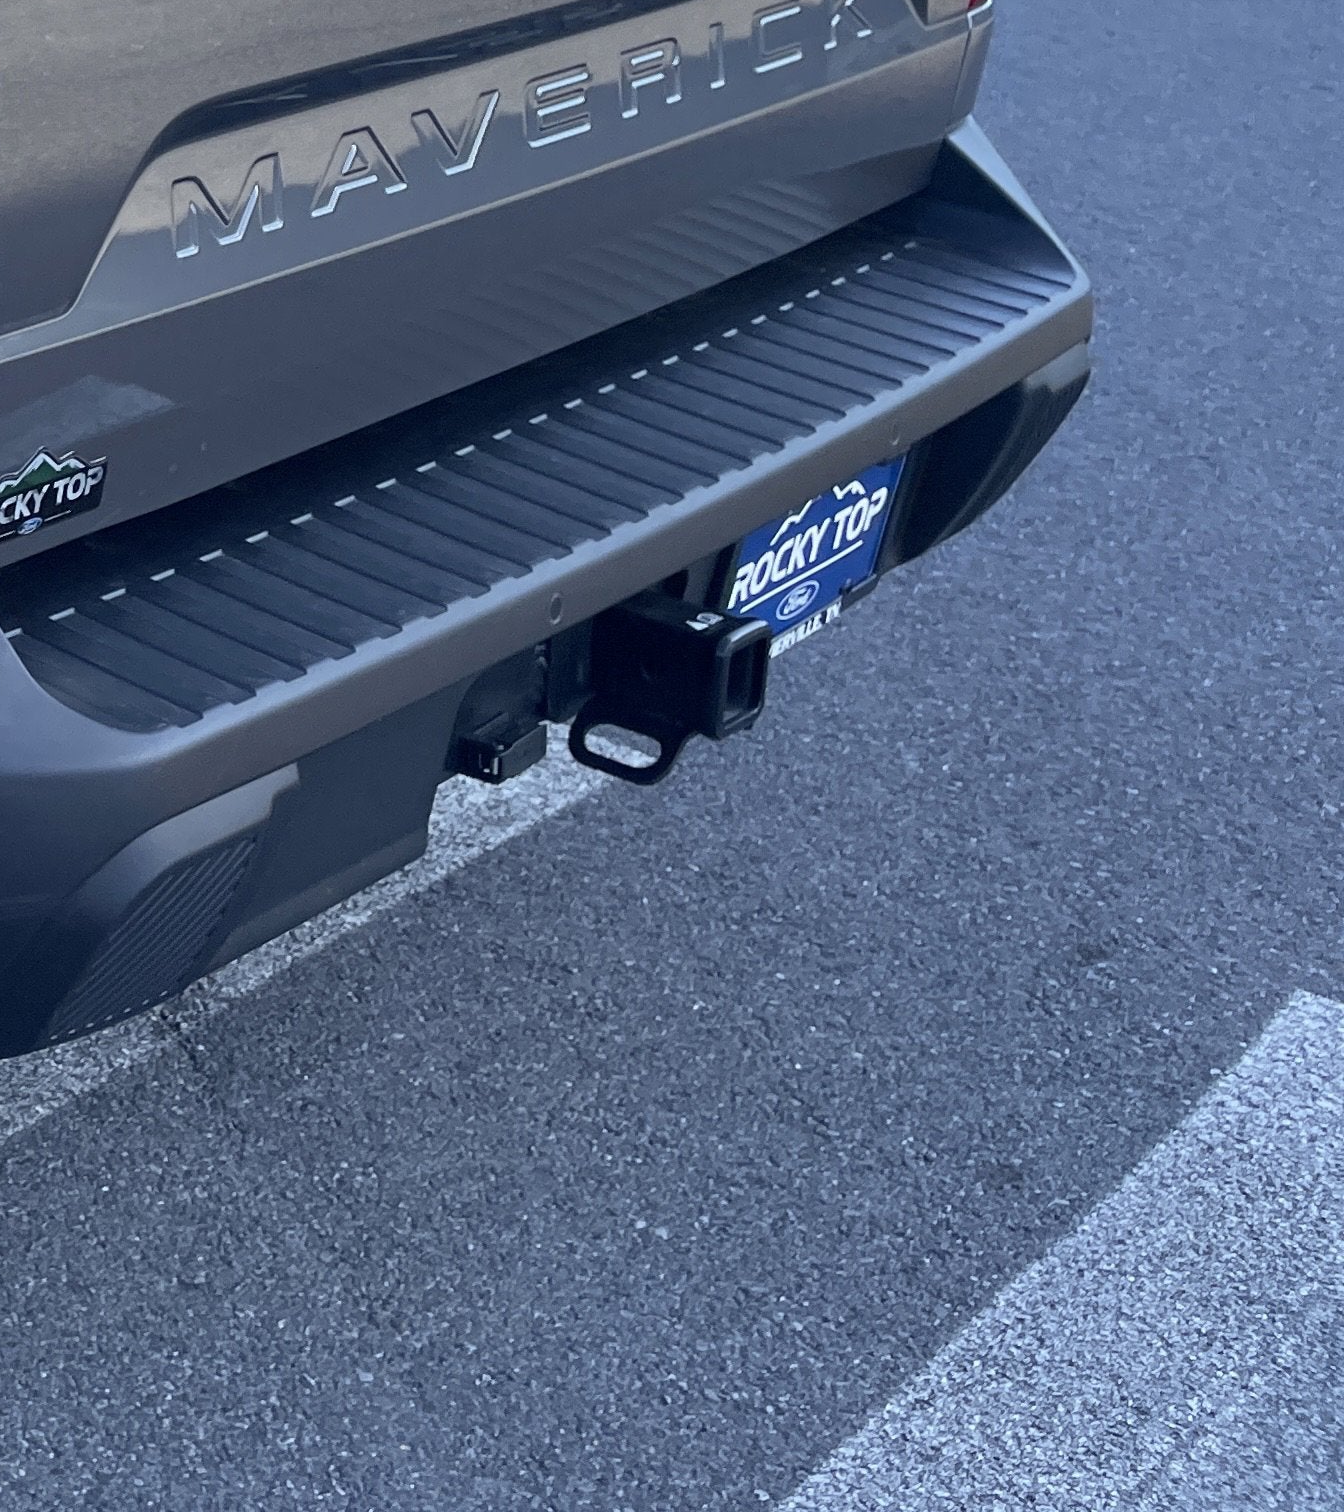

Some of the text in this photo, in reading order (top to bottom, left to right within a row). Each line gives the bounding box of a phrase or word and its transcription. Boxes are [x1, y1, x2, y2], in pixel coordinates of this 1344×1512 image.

[53, 466, 104, 506] TOP
[727, 487, 888, 610] ROCKY TOP
